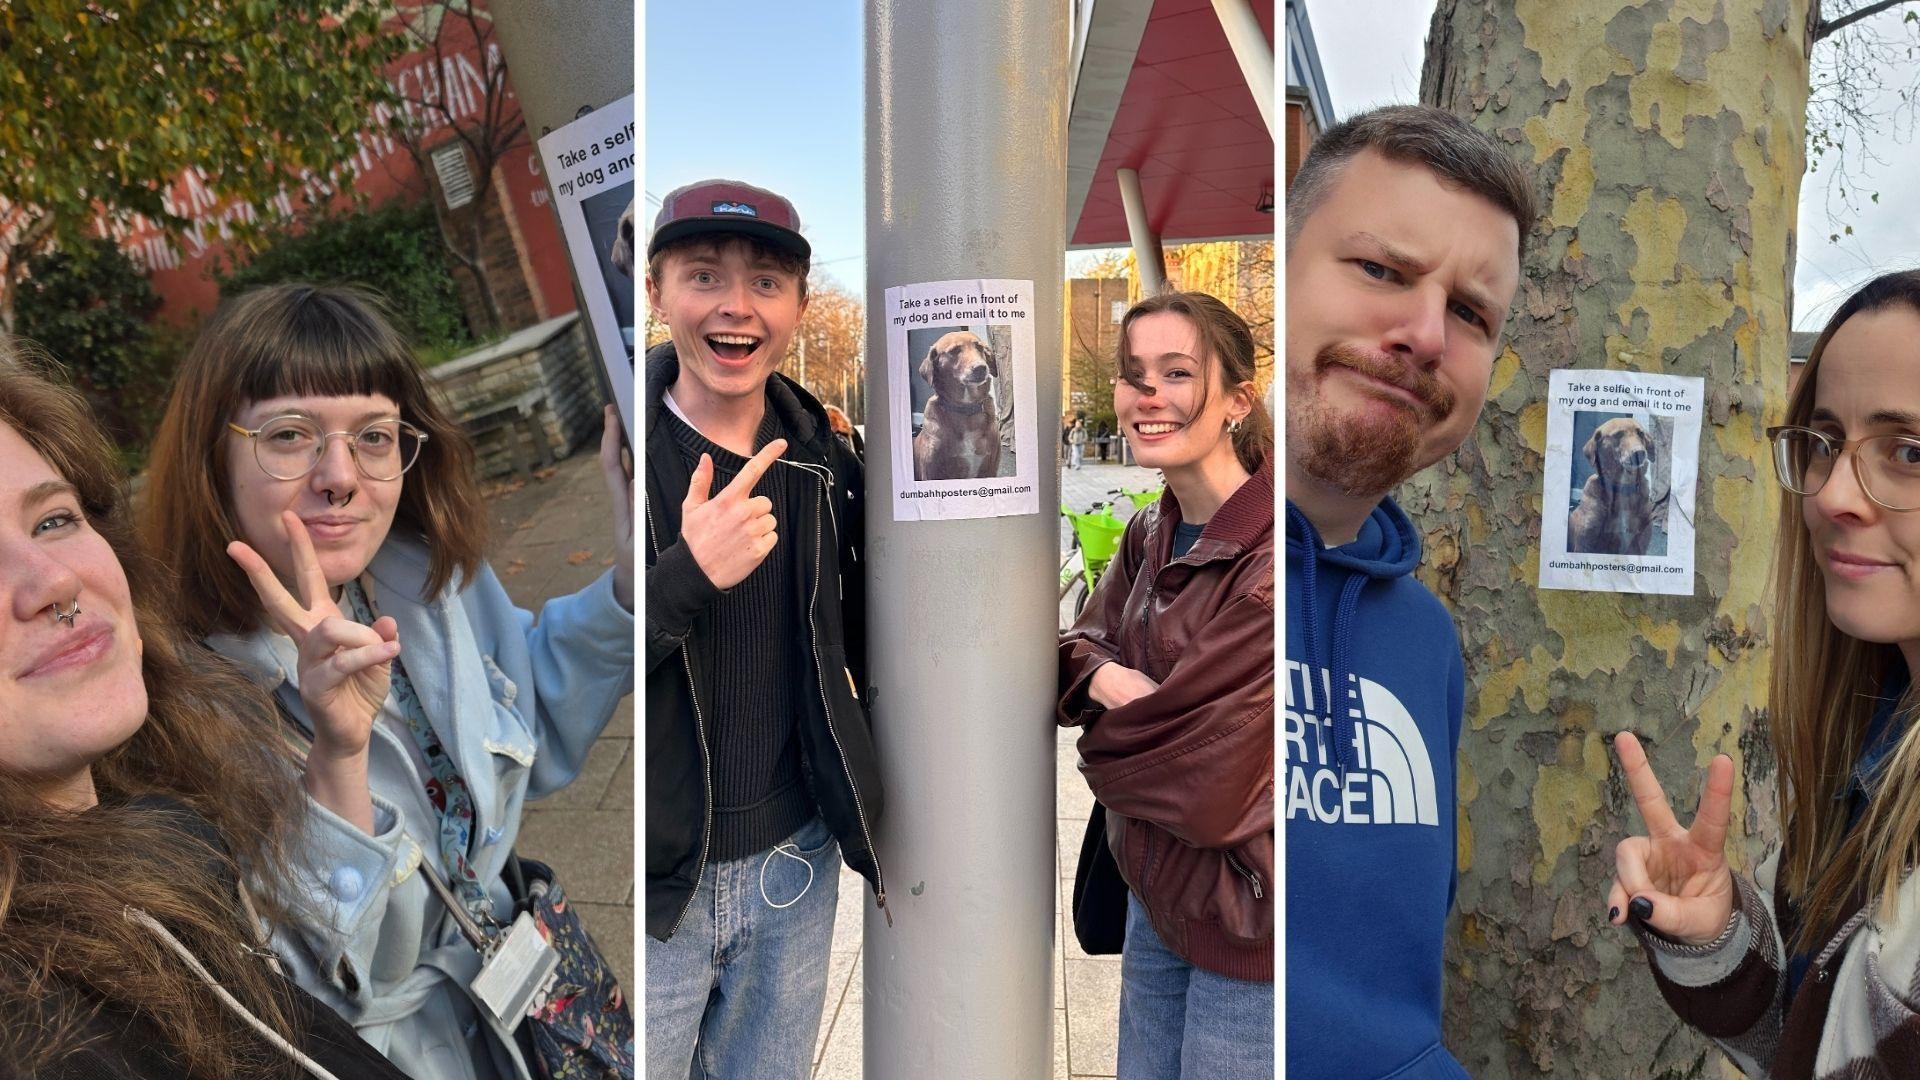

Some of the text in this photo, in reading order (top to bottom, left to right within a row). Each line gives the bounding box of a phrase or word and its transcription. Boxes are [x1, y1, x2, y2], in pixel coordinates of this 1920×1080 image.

[557, 149, 587, 170] Take
[590, 143, 600, 156] a
[558, 180, 574, 196] my
[576, 167, 605, 188] dog
[899, 294, 1019, 310] Take a selfie in front of
[893, 308, 1026, 326] my dog and email it to me
[1567, 383, 1685, 398] Take a selfie in front of
[1558, 396, 1692, 412] my dog and email it to me
[900, 485, 1031, 499] dumbahhposters@gmail.com
[1549, 560, 1684, 574] dumbahhposters@gmail.com
[1286, 764, 1370, 825] ACE
